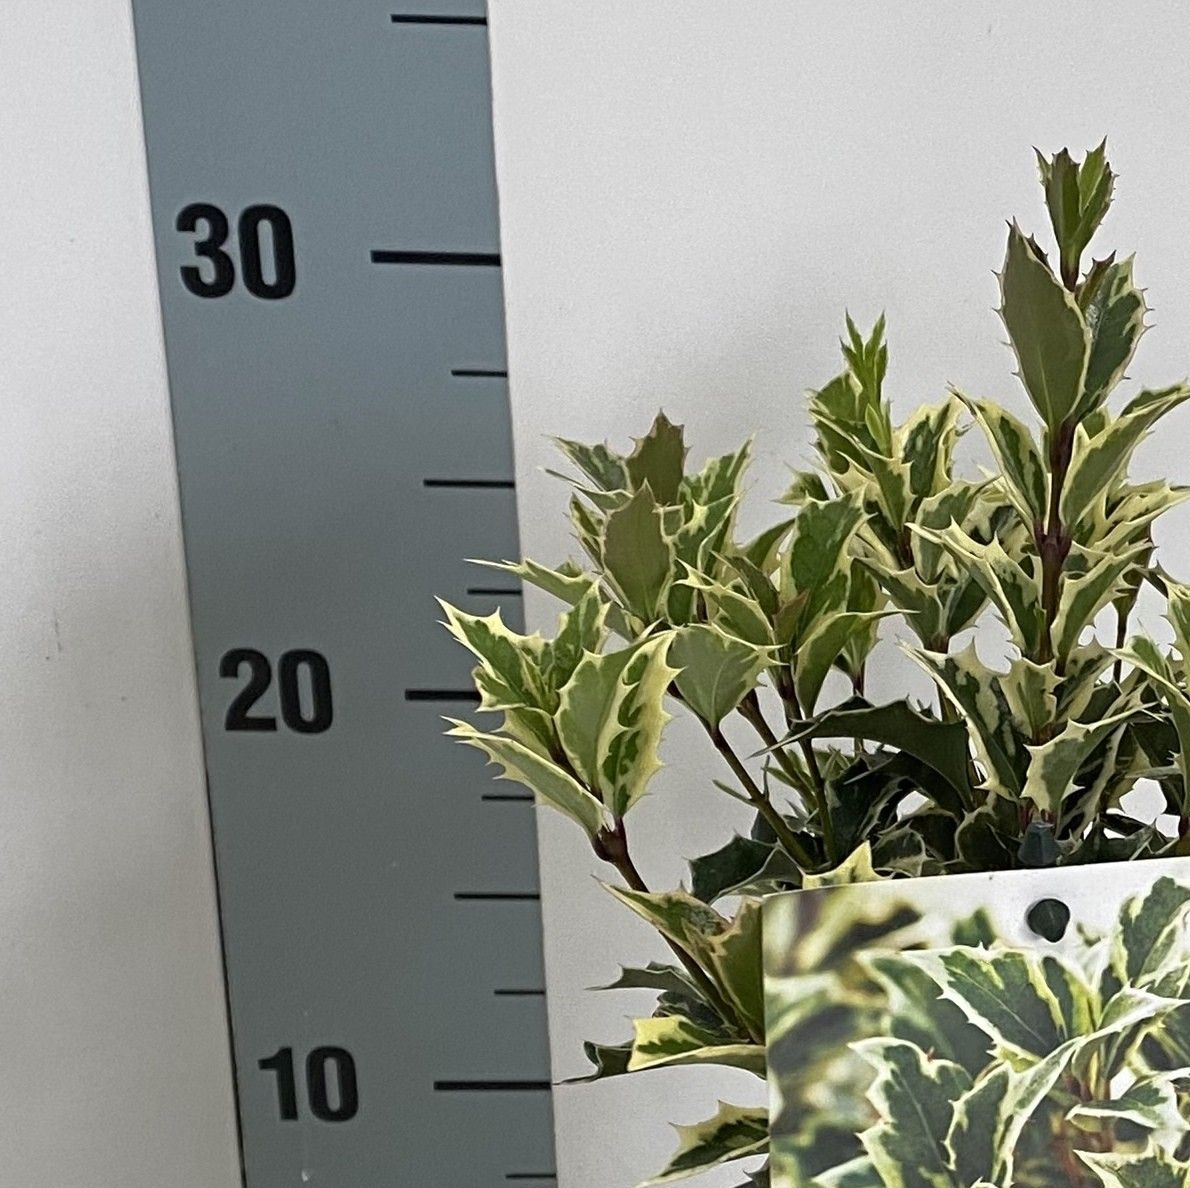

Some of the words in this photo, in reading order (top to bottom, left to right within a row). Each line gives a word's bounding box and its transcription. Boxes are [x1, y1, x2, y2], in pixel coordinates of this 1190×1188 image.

[176, 203, 296, 300] 30
[219, 648, 333, 733] 20
[258, 1046, 359, 1122] 10
